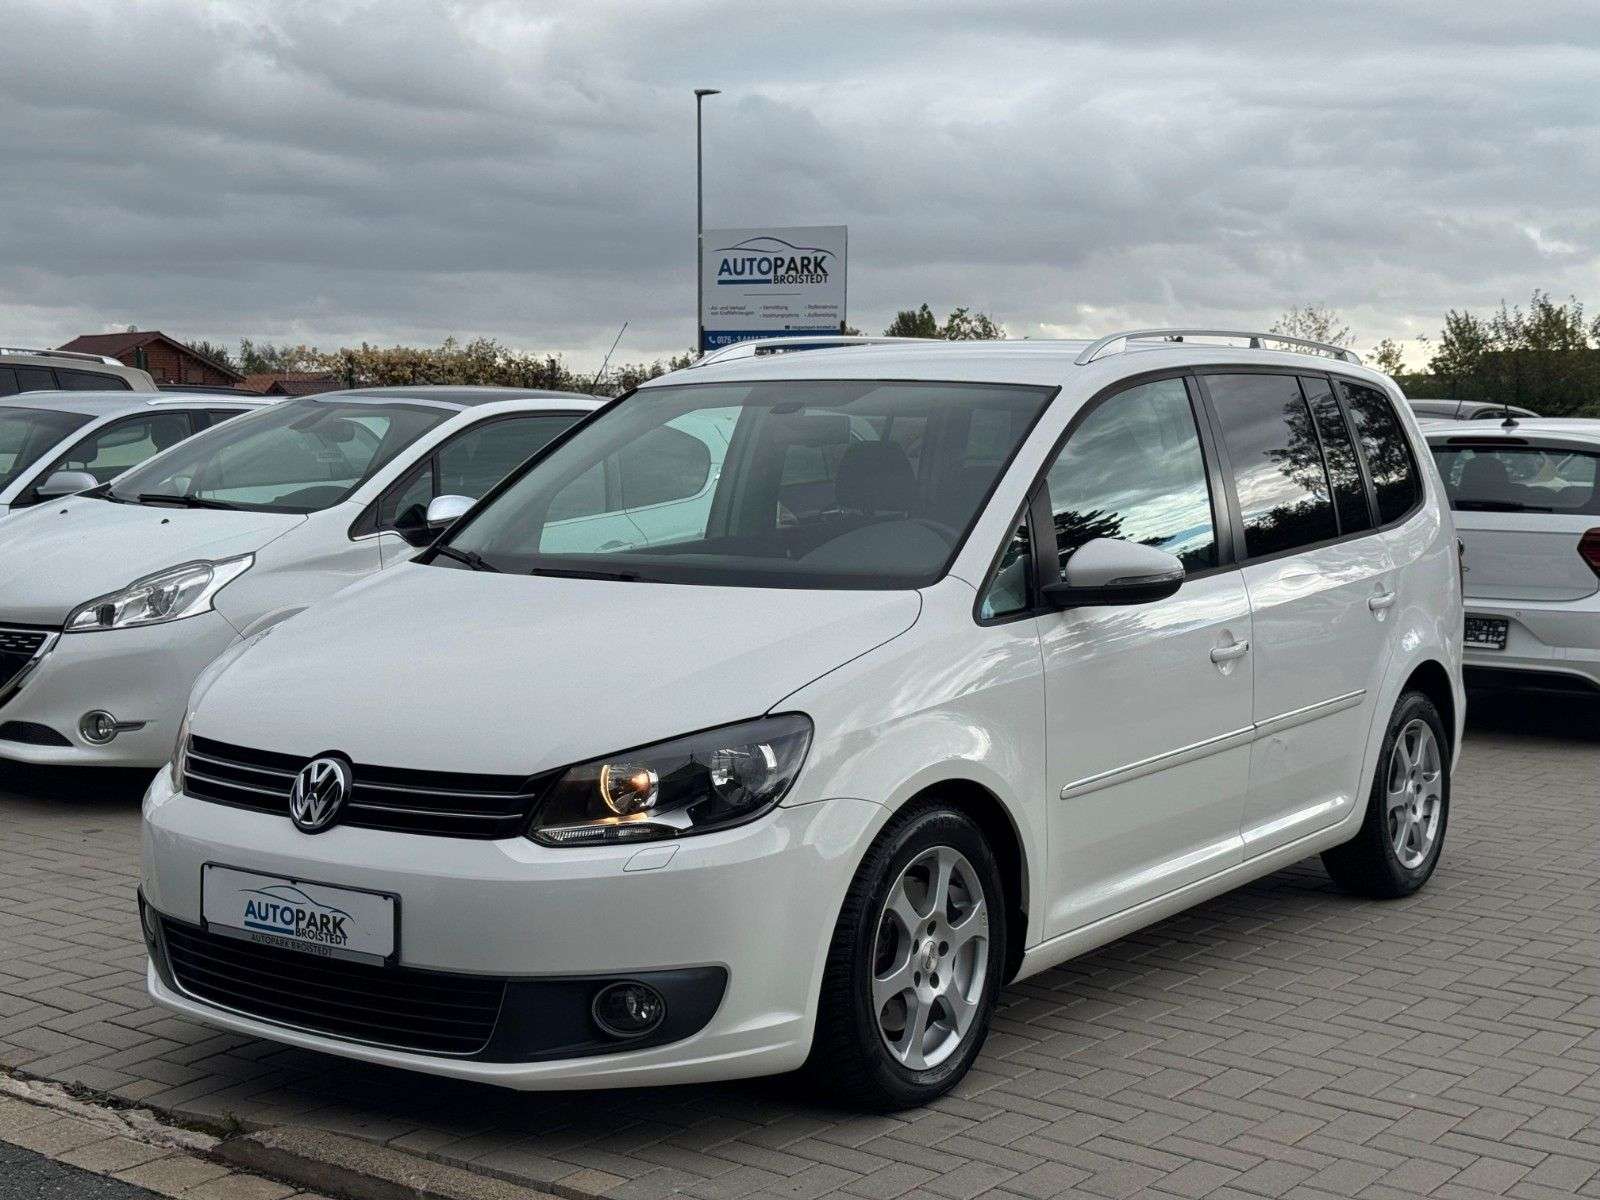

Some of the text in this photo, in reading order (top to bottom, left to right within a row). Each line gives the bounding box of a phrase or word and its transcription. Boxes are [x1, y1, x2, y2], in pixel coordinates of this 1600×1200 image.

[718, 255, 828, 276] AUTOPARK
[773, 273, 829, 285] BROISTEDT
[244, 900, 349, 939] AUTOPARK
[295, 927, 349, 947] BROISTEDT
